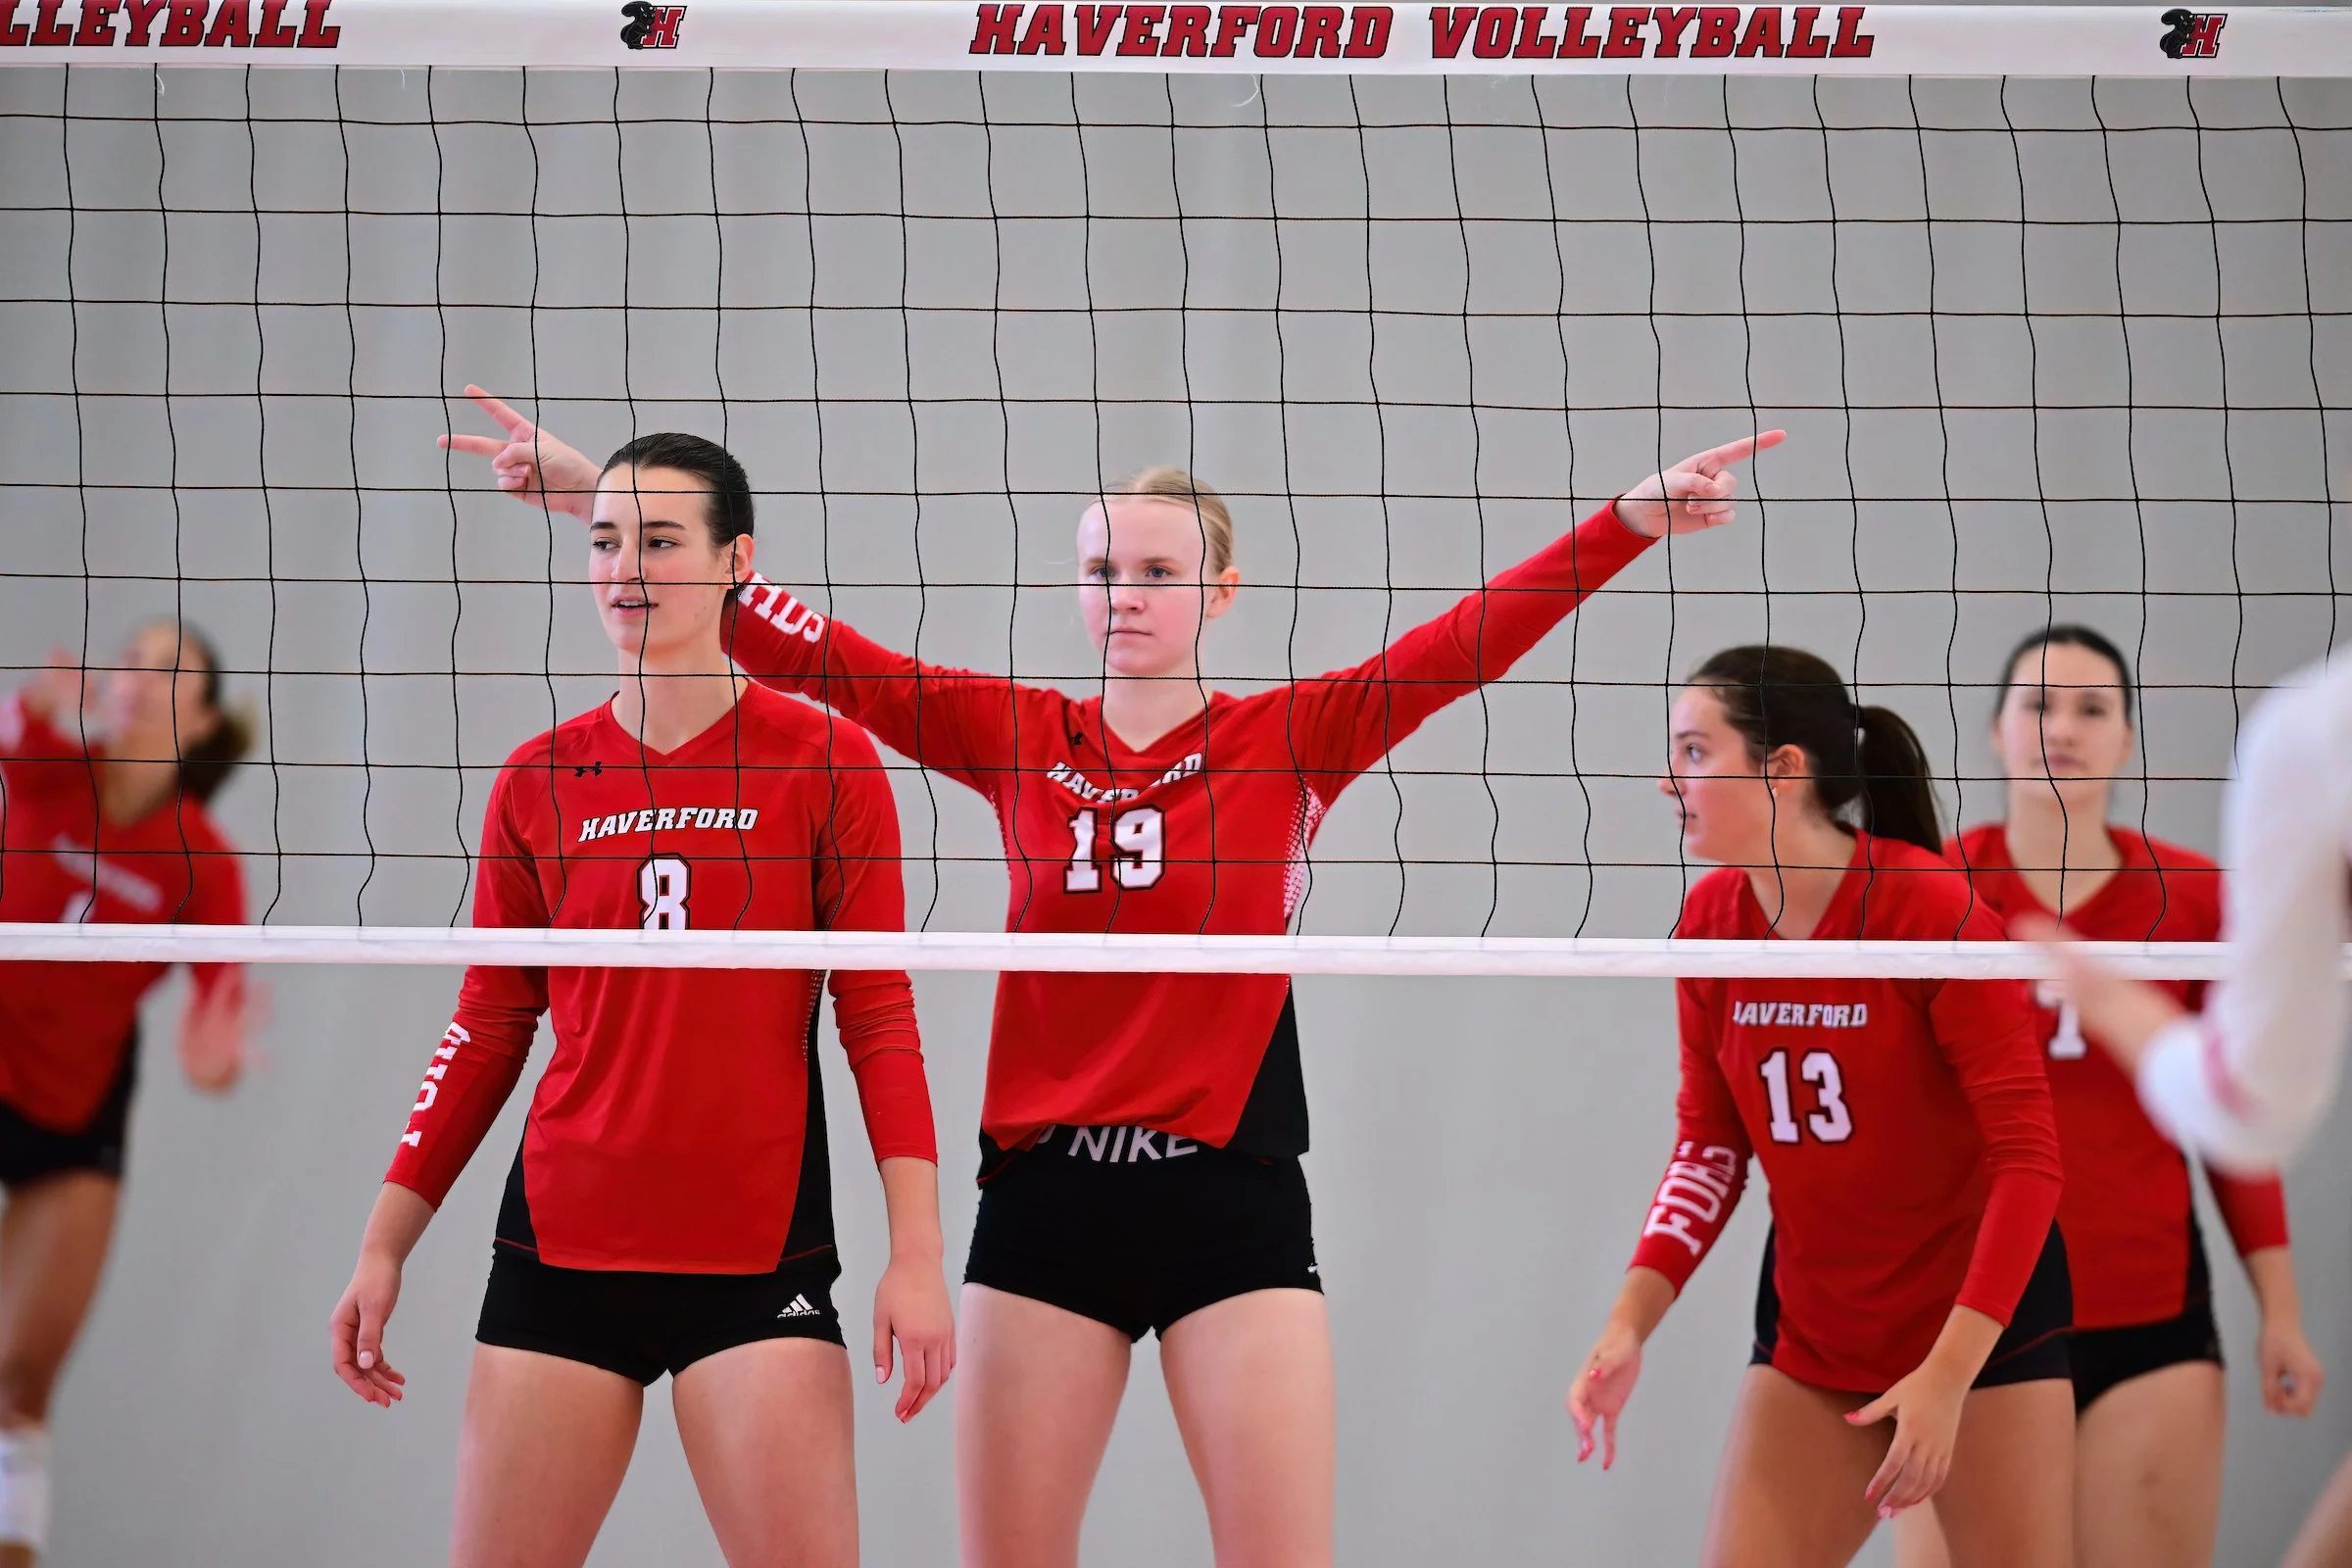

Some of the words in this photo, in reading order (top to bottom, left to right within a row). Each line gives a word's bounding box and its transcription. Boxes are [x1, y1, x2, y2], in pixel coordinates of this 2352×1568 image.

[969, 4, 1394, 59] HAVERFORD
[1429, 6, 1875, 59] VOLLEYBALL
[576, 807, 760, 843] HAVERFORD
[1063, 805, 1165, 894] 19
[637, 853, 692, 930] 8
[1760, 1049, 1853, 1144] 13
[1067, 1125, 1199, 1163] NIKE
